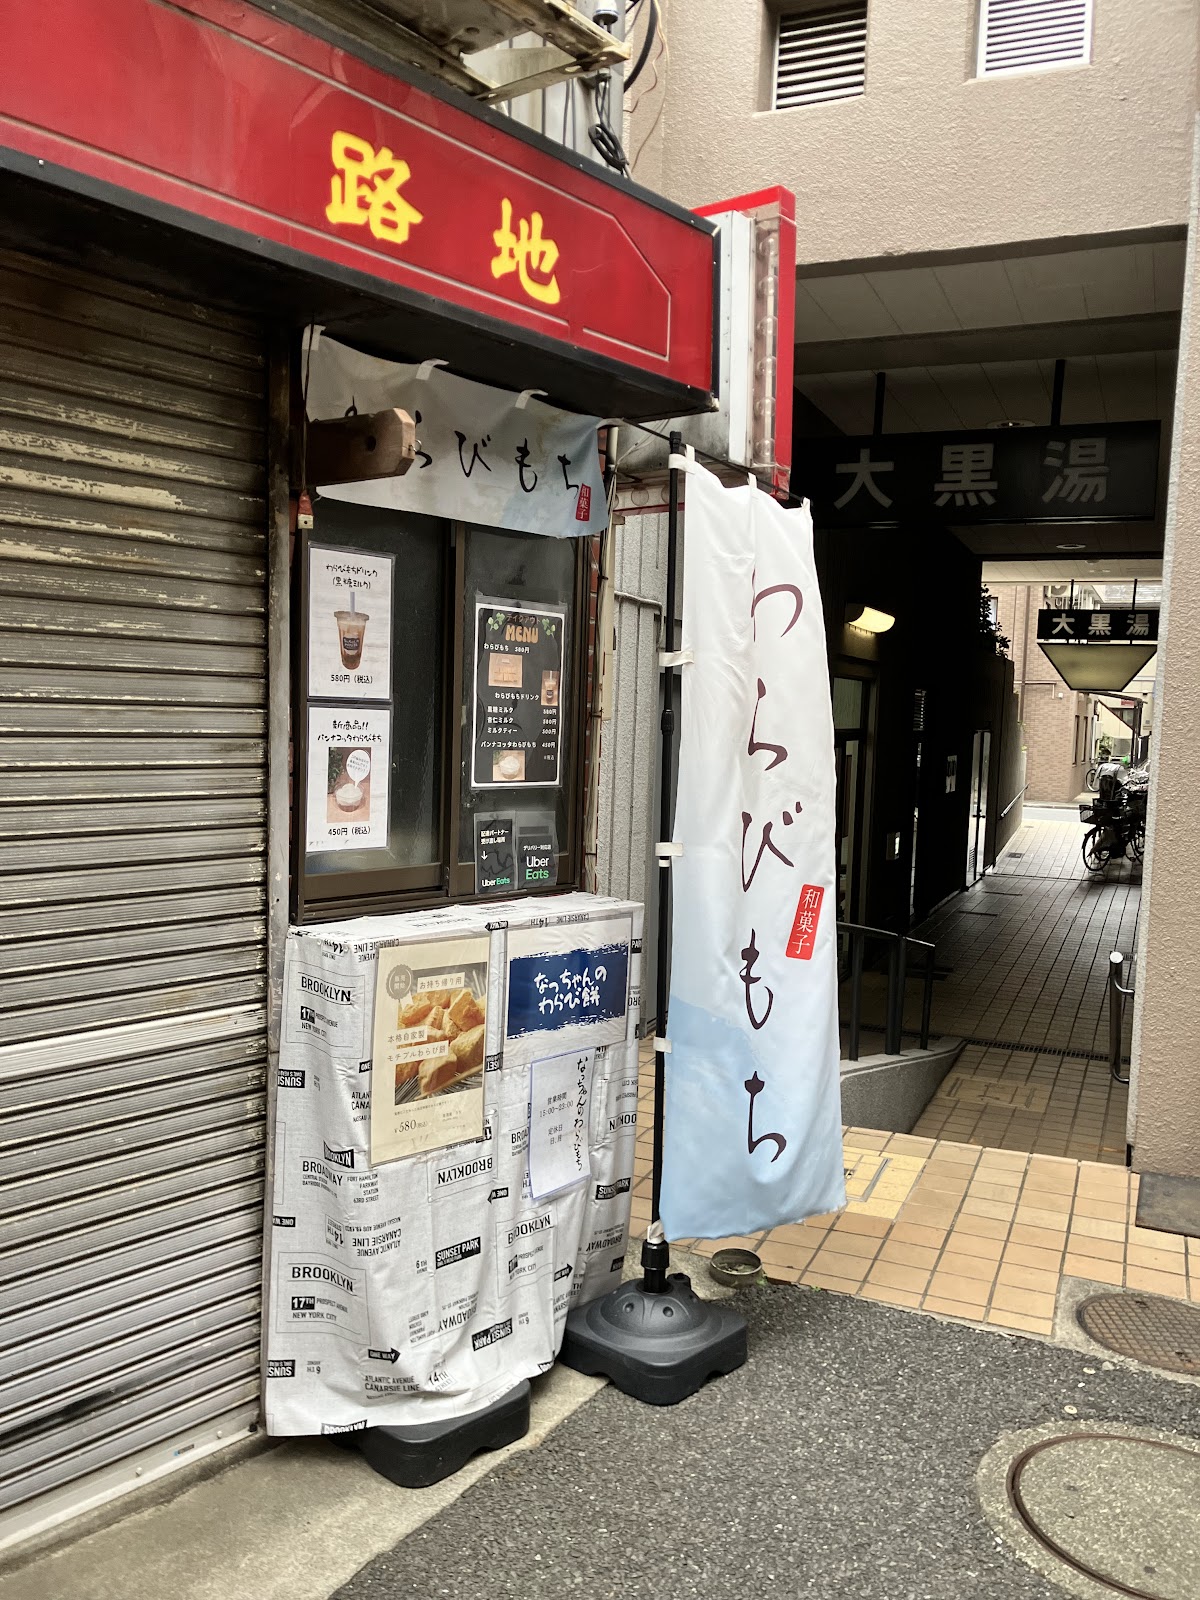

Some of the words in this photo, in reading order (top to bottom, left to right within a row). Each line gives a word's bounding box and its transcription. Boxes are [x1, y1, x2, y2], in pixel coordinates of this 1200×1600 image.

[326, 130, 560, 304] 路地
[834, 437, 1110, 510] 大黒湯
[326, 563, 378, 577] わらびもちドリンク
[332, 576, 371, 589] (黒糖ミルク)
[1052, 613, 1150, 636] 大黒湯
[505, 624, 539, 643] MENU
[484, 643, 509, 651] わらびもち
[495, 692, 540, 700] わらびもちドリンク
[317, 733, 382, 743] パンナコッタわらびもち
[526, 856, 549, 867] Uber
[739, 567, 804, 1163] わらびもち
[525, 868, 549, 880] Eats
[481, 879, 496, 887] Uber
[496, 877, 511, 885] Eats
[792, 888, 822, 955] 和菓子
[420, 976, 462, 989] お持ち帰り用
[534, 966, 607, 994] なっちゃんの
[538, 985, 600, 1015] わらび餅
[388, 1030, 425, 1043] 本格自家製
[437, 1157, 493, 1185] BROOKLYN
[281, 1218, 294, 1226] ONE
[327, 1225, 344, 1245] 14TH
[508, 1215, 551, 1244] BOOKLYN
[352, 1238, 370, 1247] LINE
[372, 1228, 402, 1246] CANARSIE
[357, 1248, 380, 1257] AVENUE
[437, 1245, 461, 1263] SUNSET
[462, 1239, 480, 1253] PARK
[291, 1266, 353, 1292] BROOKLYN
[292, 1297, 315, 1309] 17TH
[474, 1335, 492, 1350] PARK
[382, 1352, 395, 1360] WAY
[392, 1376, 415, 1384] AVENUE
[365, 1383, 401, 1392] CANARSIE
[403, 1383, 420, 1392] LINE
